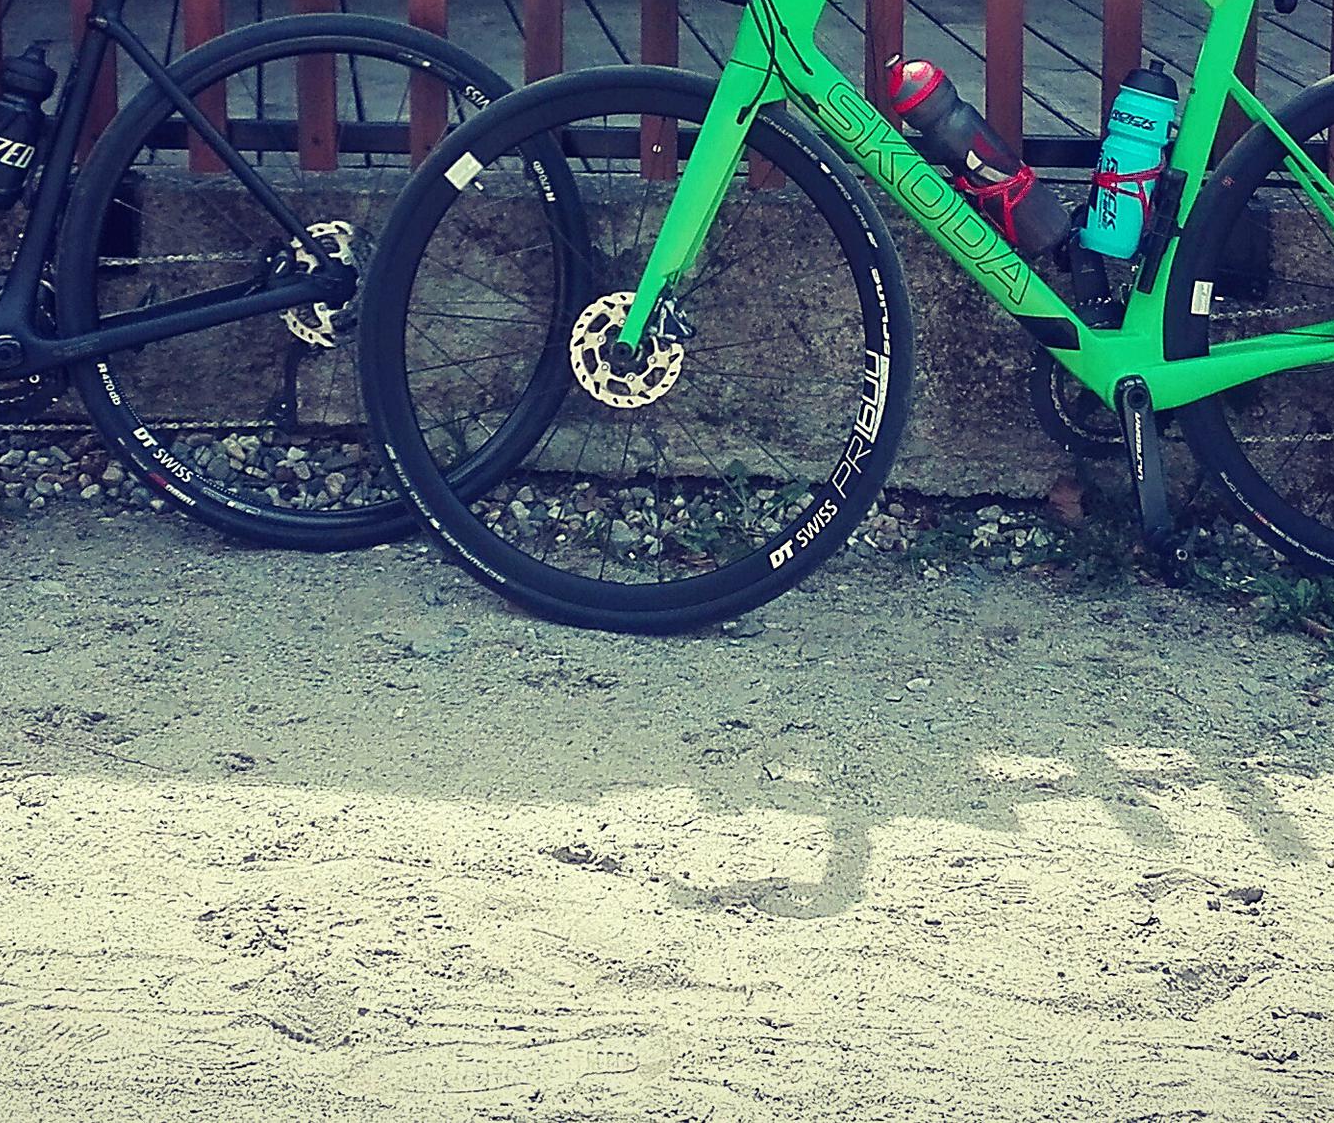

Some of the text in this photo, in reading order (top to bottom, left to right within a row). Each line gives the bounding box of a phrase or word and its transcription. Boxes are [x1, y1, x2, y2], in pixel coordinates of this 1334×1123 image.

[133, 427, 195, 483] DT SWISS
[769, 540, 795, 569] DT
[796, 499, 838, 548] SWISS
